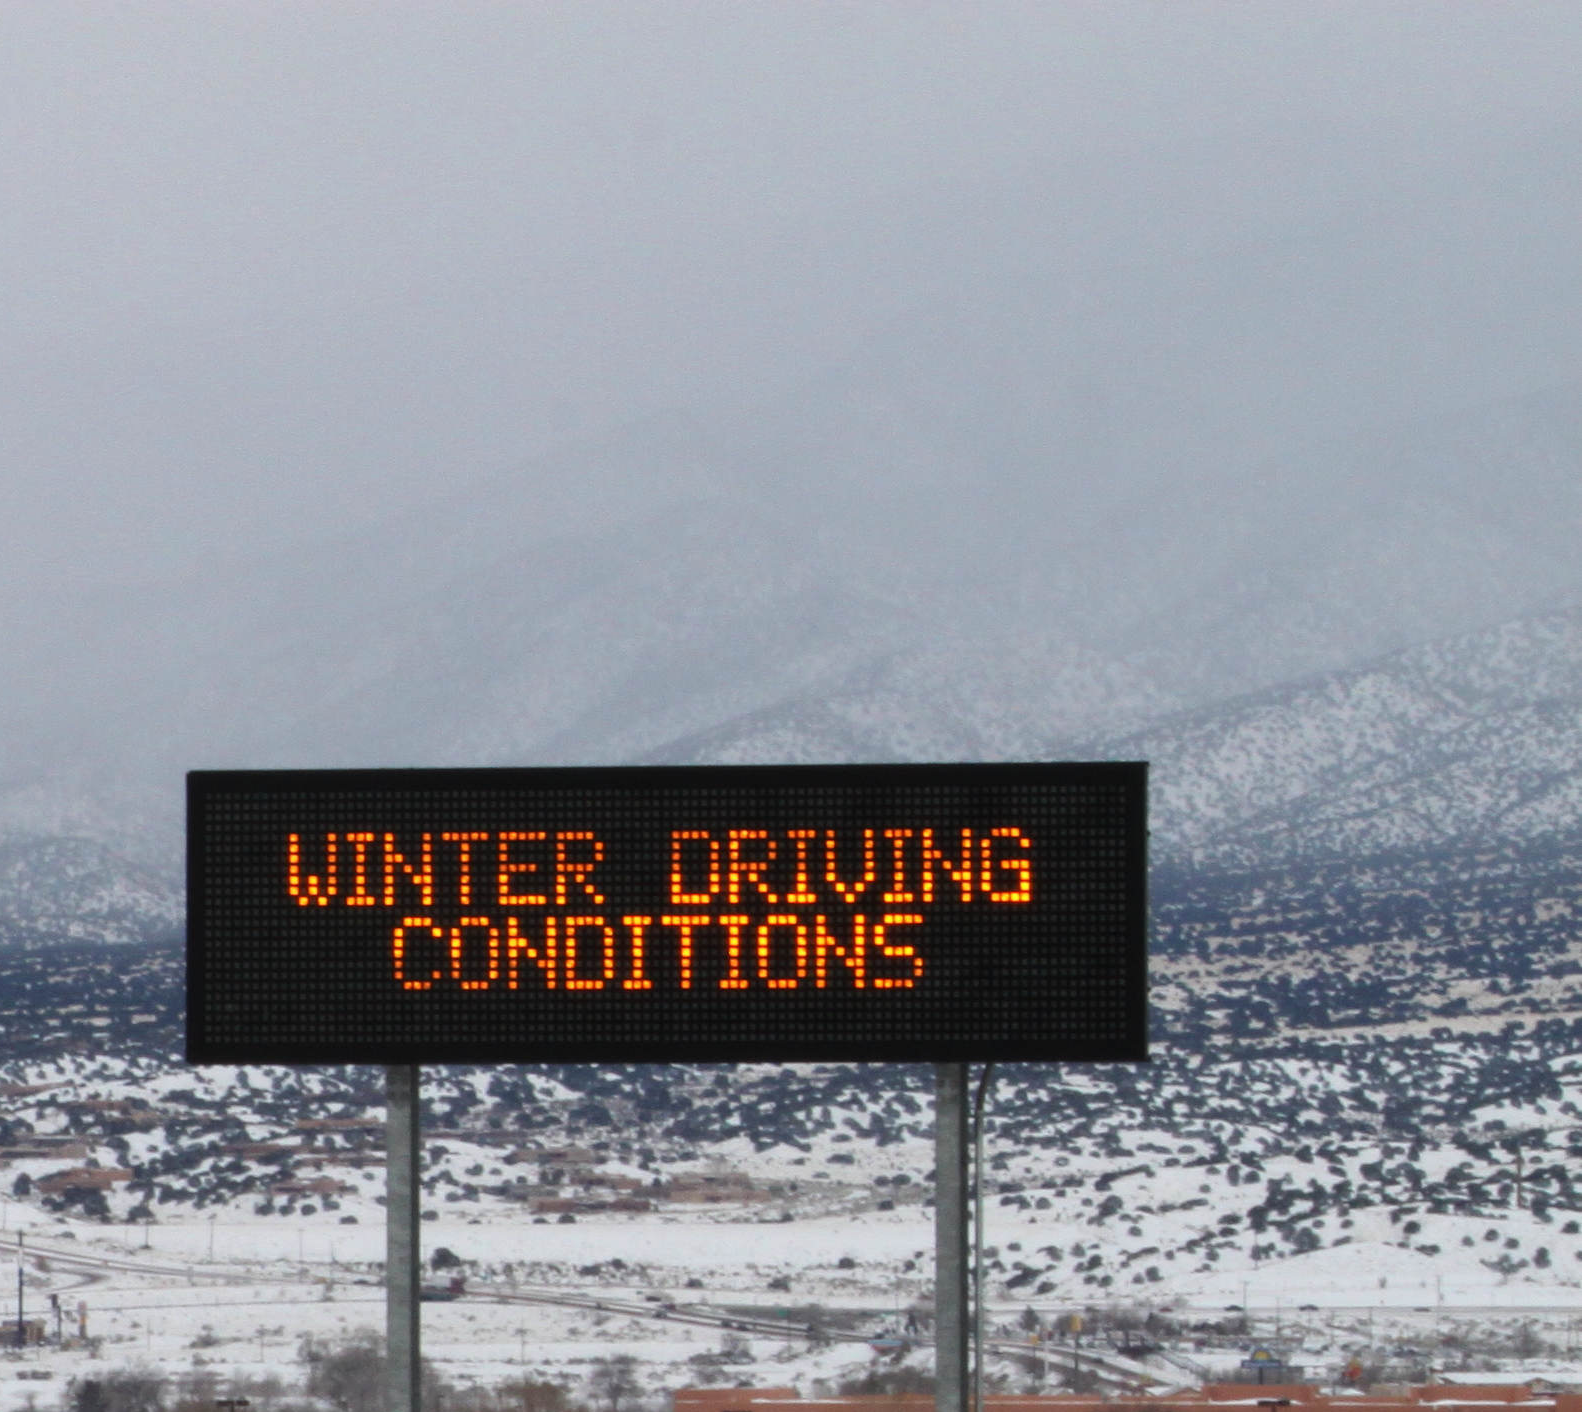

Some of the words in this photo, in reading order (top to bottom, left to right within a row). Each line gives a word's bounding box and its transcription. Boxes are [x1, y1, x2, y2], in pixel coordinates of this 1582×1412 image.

[288, 831, 605, 907] WINTER
[669, 827, 1033, 905] DRIVING
[392, 912, 924, 991] CONDITIONS
